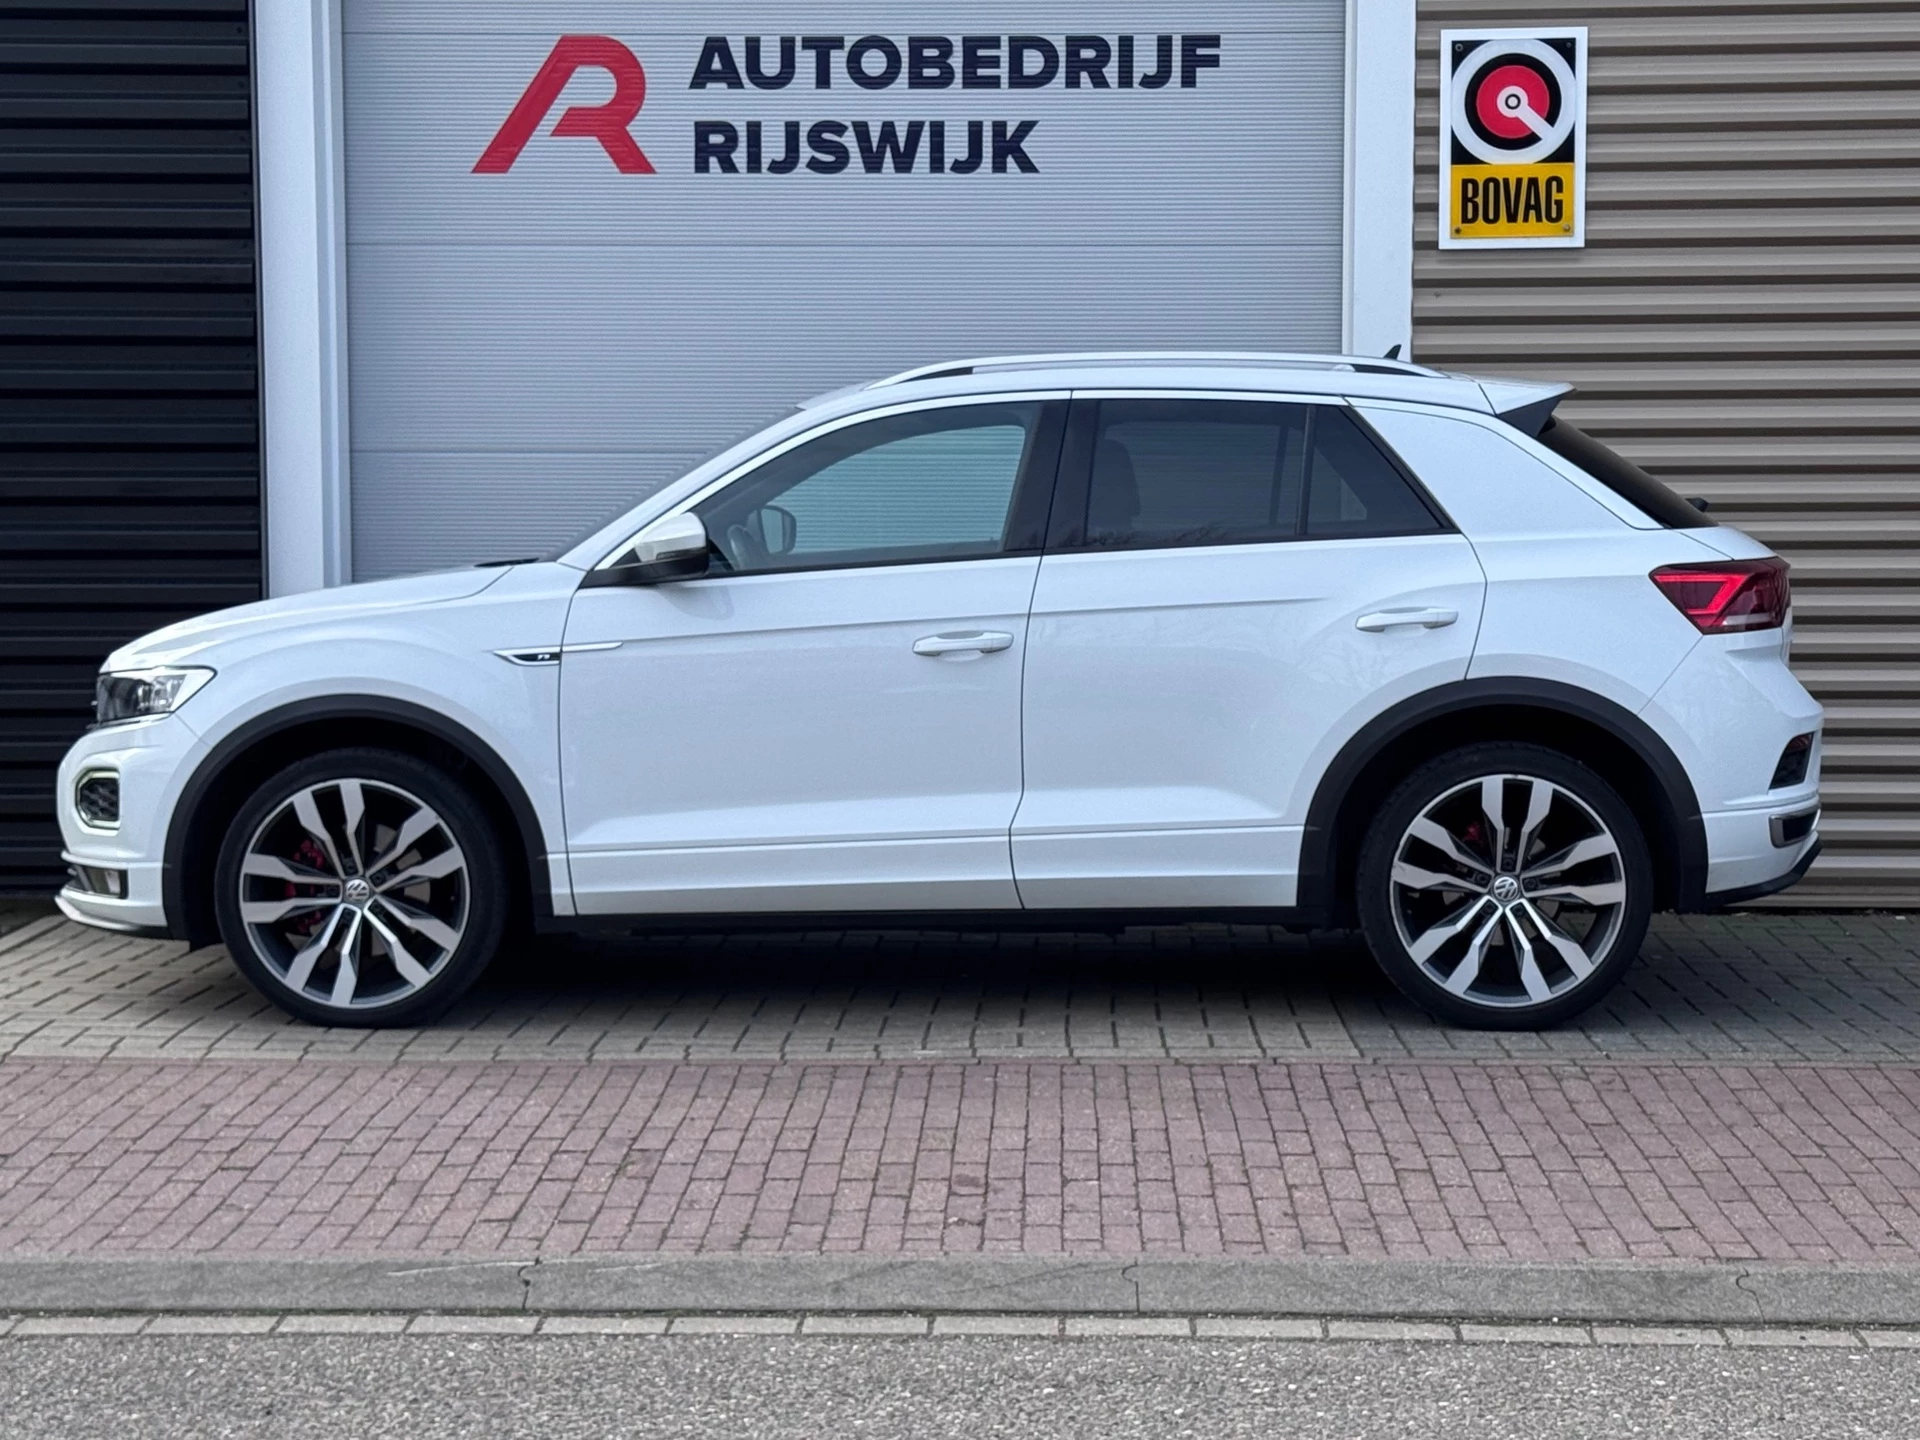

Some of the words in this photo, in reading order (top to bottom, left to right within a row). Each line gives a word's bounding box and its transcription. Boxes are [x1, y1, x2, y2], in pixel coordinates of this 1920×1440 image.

[689, 35, 1221, 90] AUTOBEDRIJF
[694, 120, 1040, 175] RIJSWIJK
[1461, 175, 1564, 225] BOVAG
